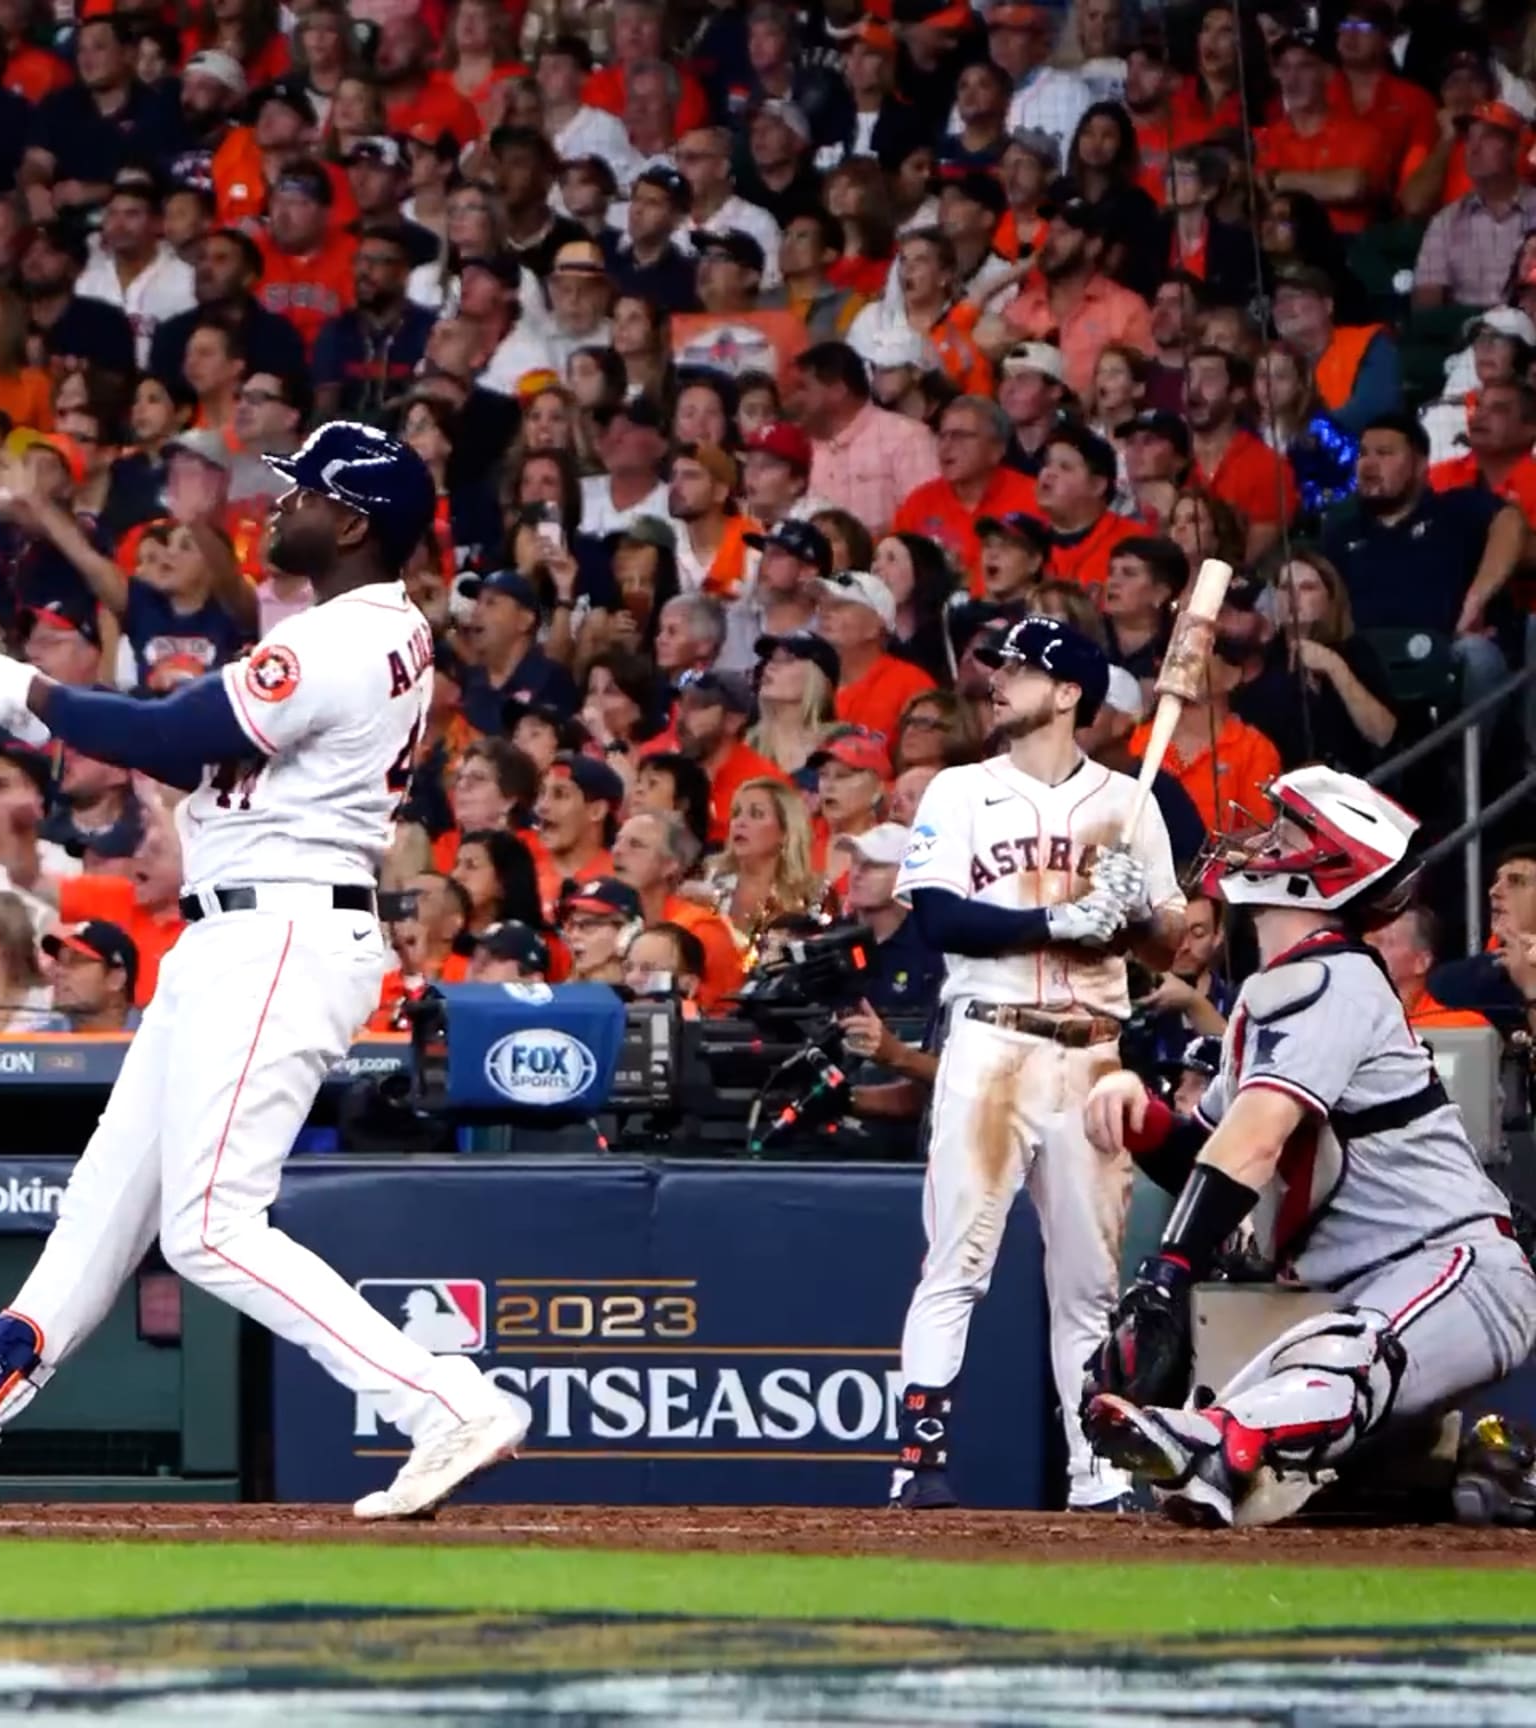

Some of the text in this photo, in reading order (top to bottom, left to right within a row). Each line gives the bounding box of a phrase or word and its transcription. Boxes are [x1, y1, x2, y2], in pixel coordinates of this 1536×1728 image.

[969, 836, 1098, 893] ASTRO
[511, 1045, 570, 1075] FOX
[510, 1075, 571, 1088] SPORTS
[497, 1296, 696, 1337] 2023
[906, 1393, 926, 1410] 30
[901, 1447, 922, 1463] 30
